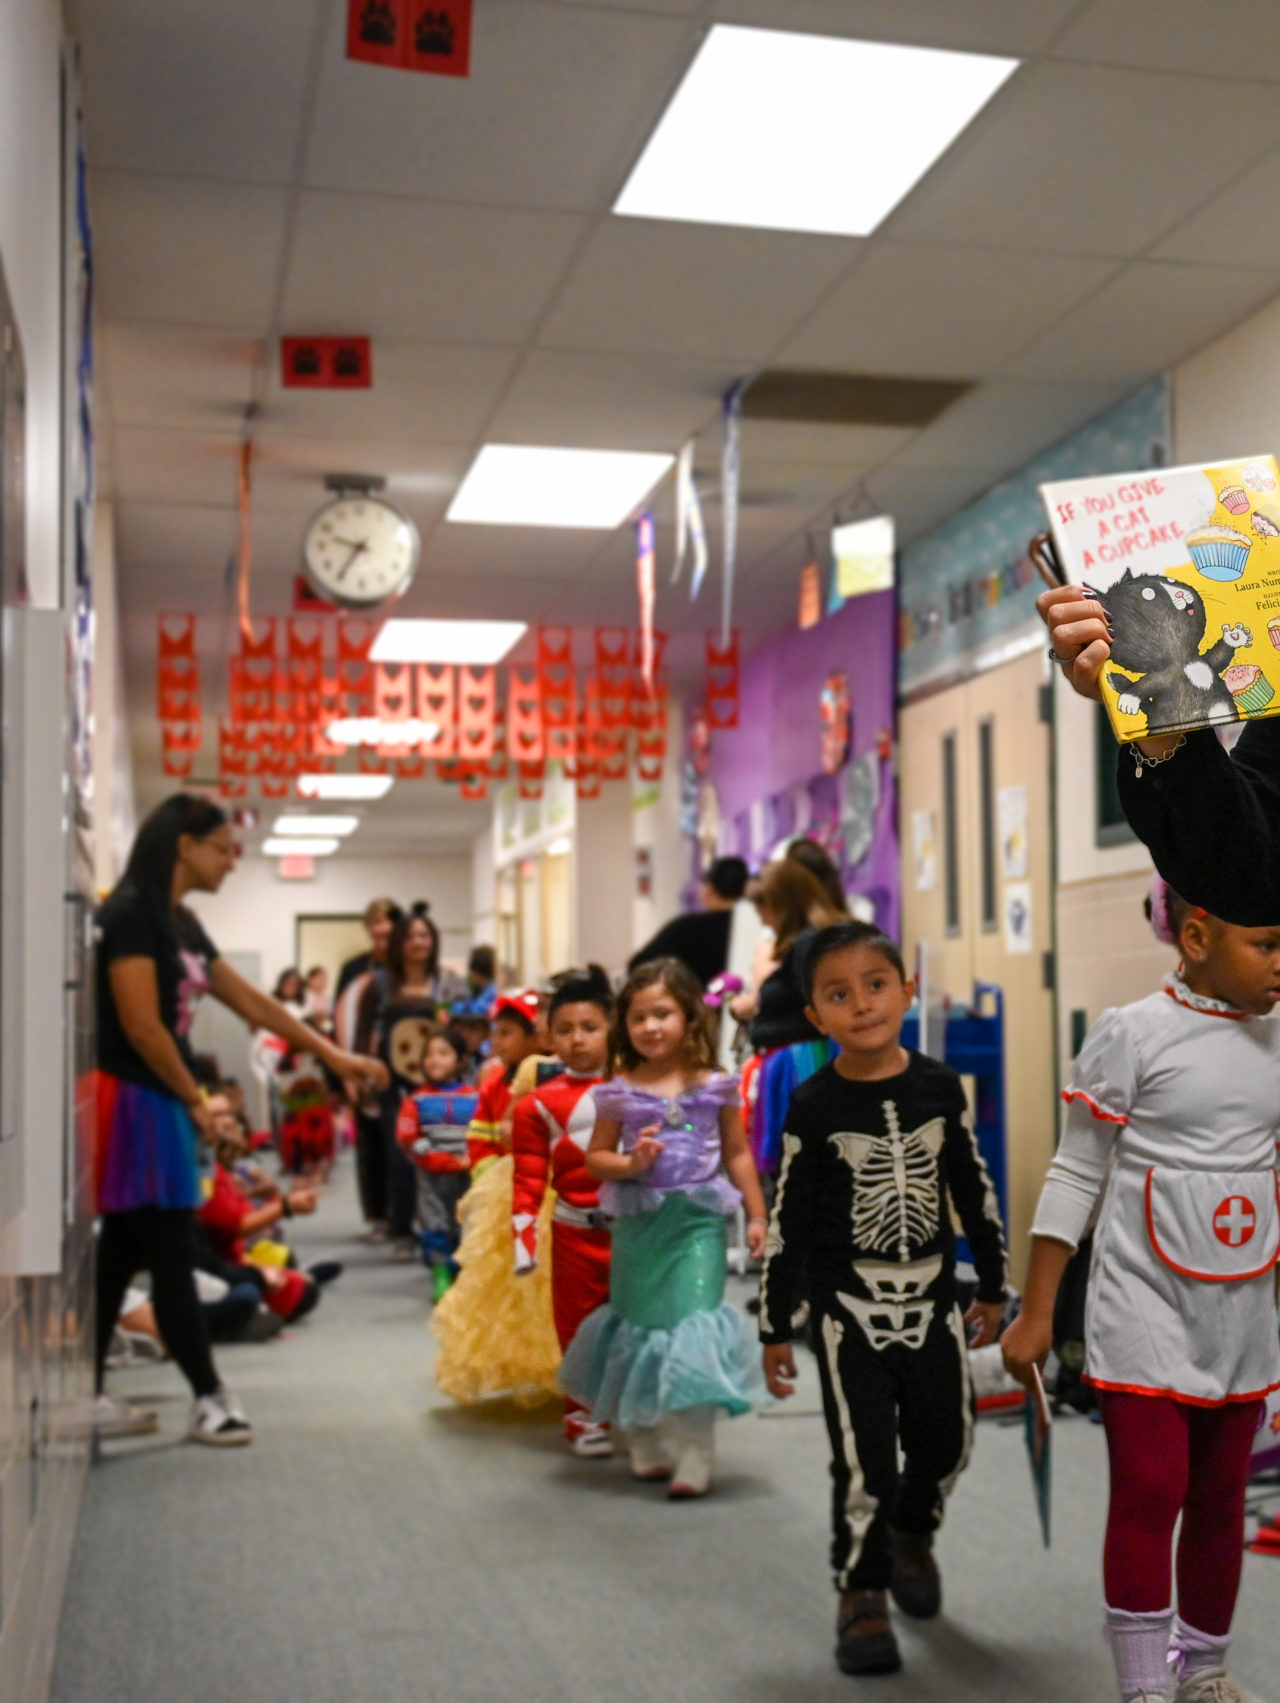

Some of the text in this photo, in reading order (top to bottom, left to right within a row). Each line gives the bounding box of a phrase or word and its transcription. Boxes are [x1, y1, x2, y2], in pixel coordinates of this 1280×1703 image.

[1056, 477, 1166, 525] IF YOU GIVE
[1098, 505, 1150, 539] A CAT
[1083, 520, 1185, 571] A CUPCAKE
[1234, 582, 1260, 592] Laura
